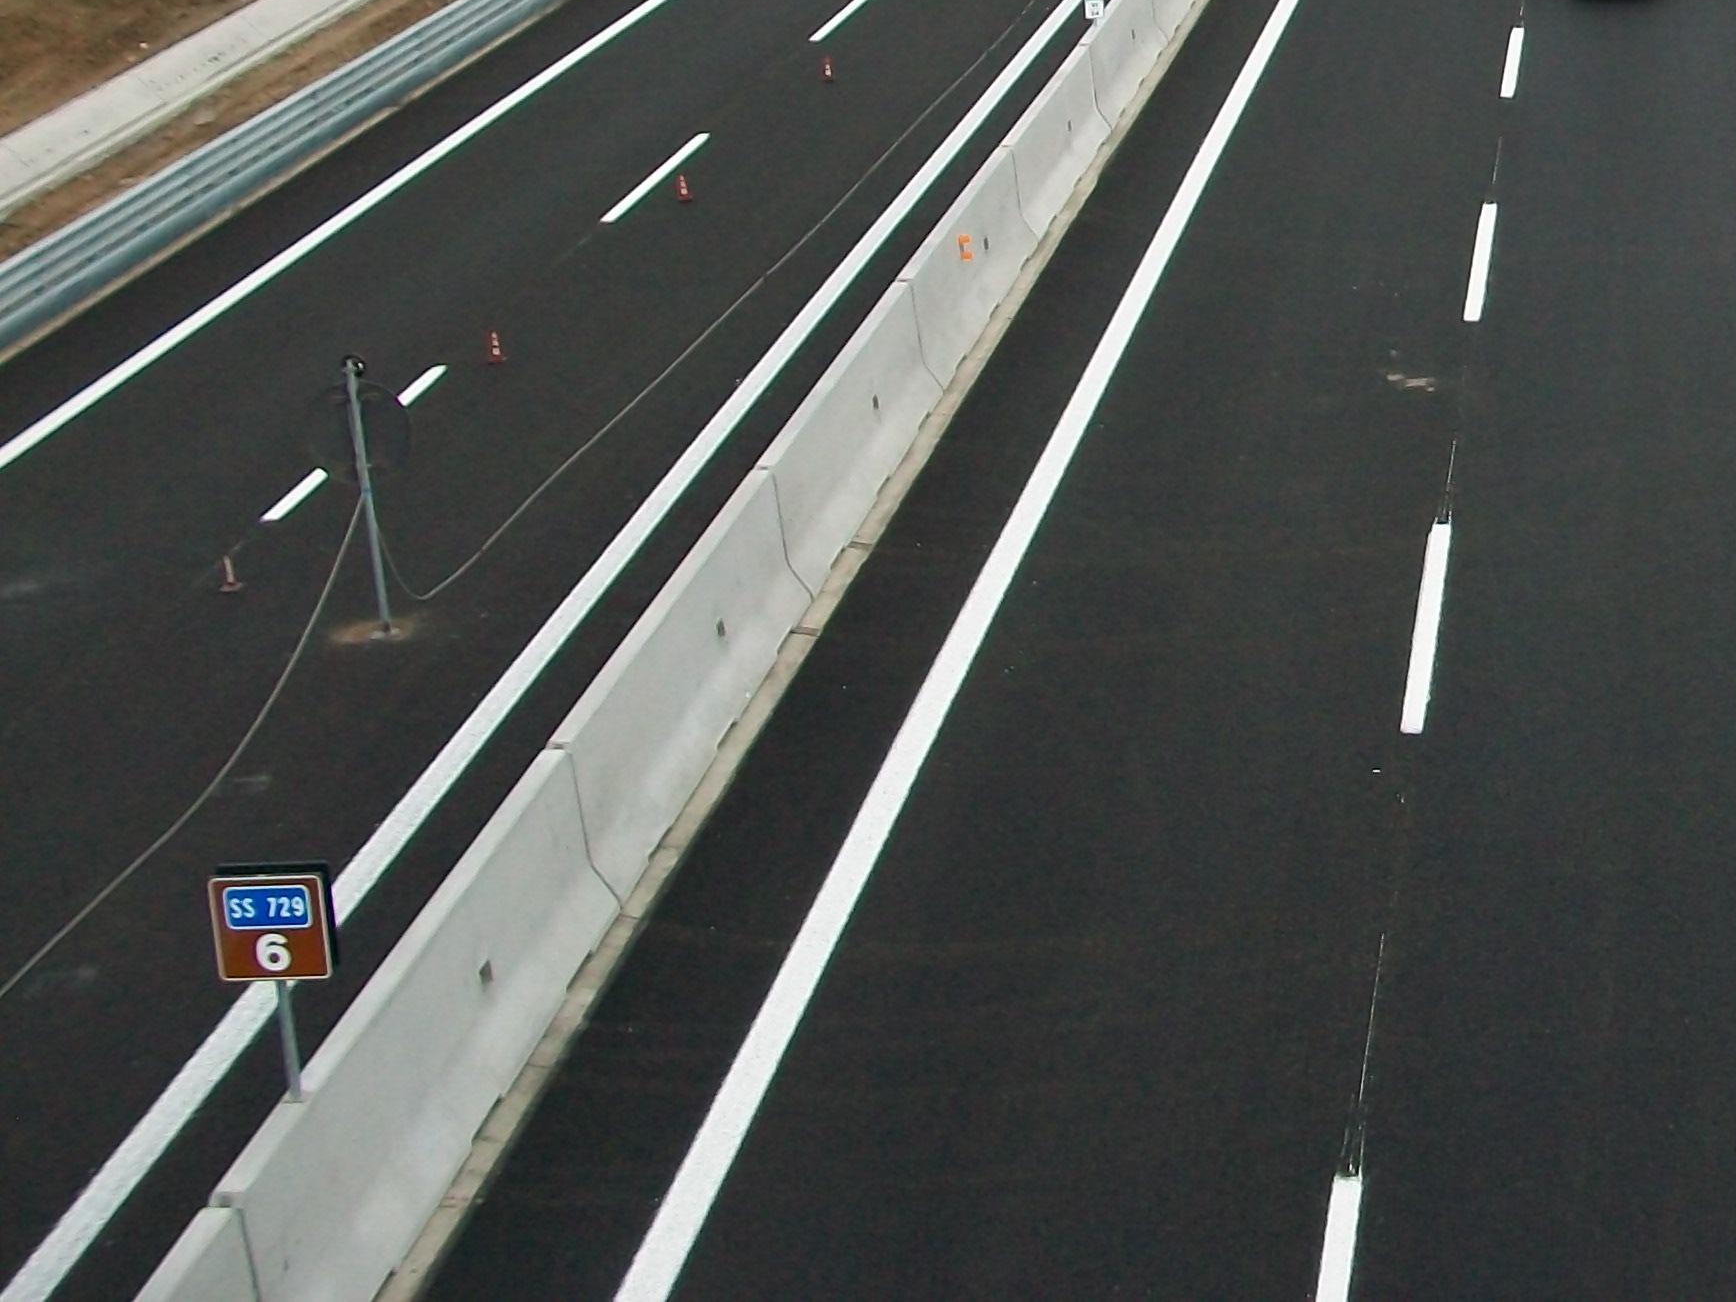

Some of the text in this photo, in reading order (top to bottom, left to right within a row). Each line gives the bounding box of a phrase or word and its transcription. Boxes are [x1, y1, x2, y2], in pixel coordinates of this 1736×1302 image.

[229, 896, 305, 918] SS 729
[256, 933, 292, 971] 6
